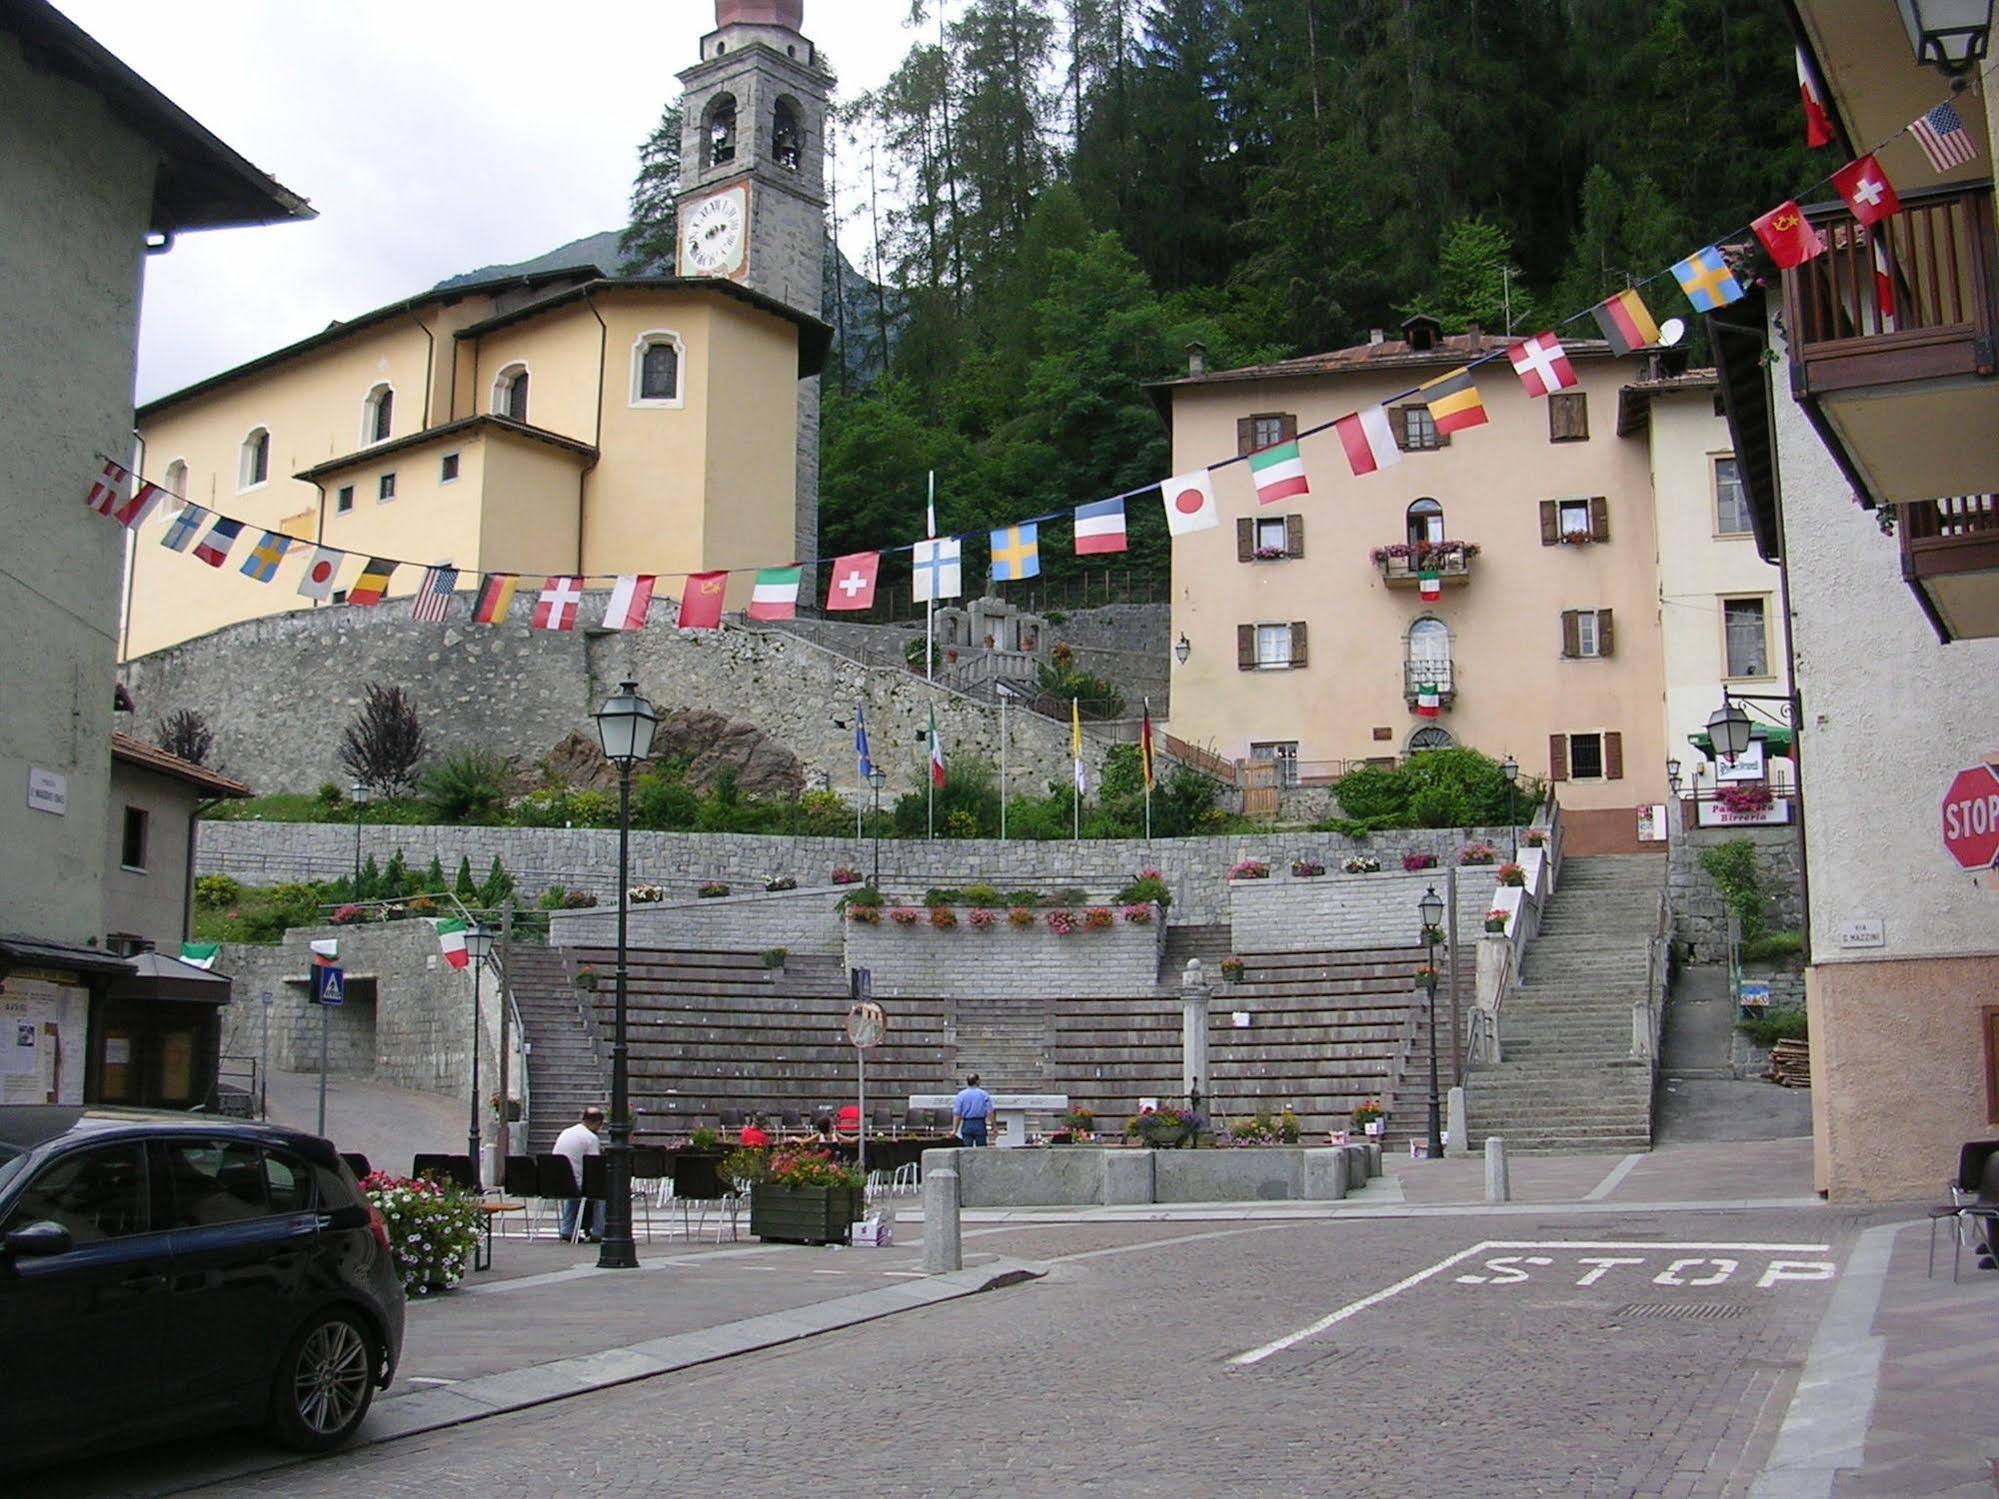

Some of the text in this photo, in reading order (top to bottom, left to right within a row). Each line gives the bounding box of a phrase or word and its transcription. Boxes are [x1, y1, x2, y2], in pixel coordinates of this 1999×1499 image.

[1720, 813, 1767, 822] Birreria
[1946, 794, 1999, 840] STOP
[1455, 1256, 1837, 1288] STOP
